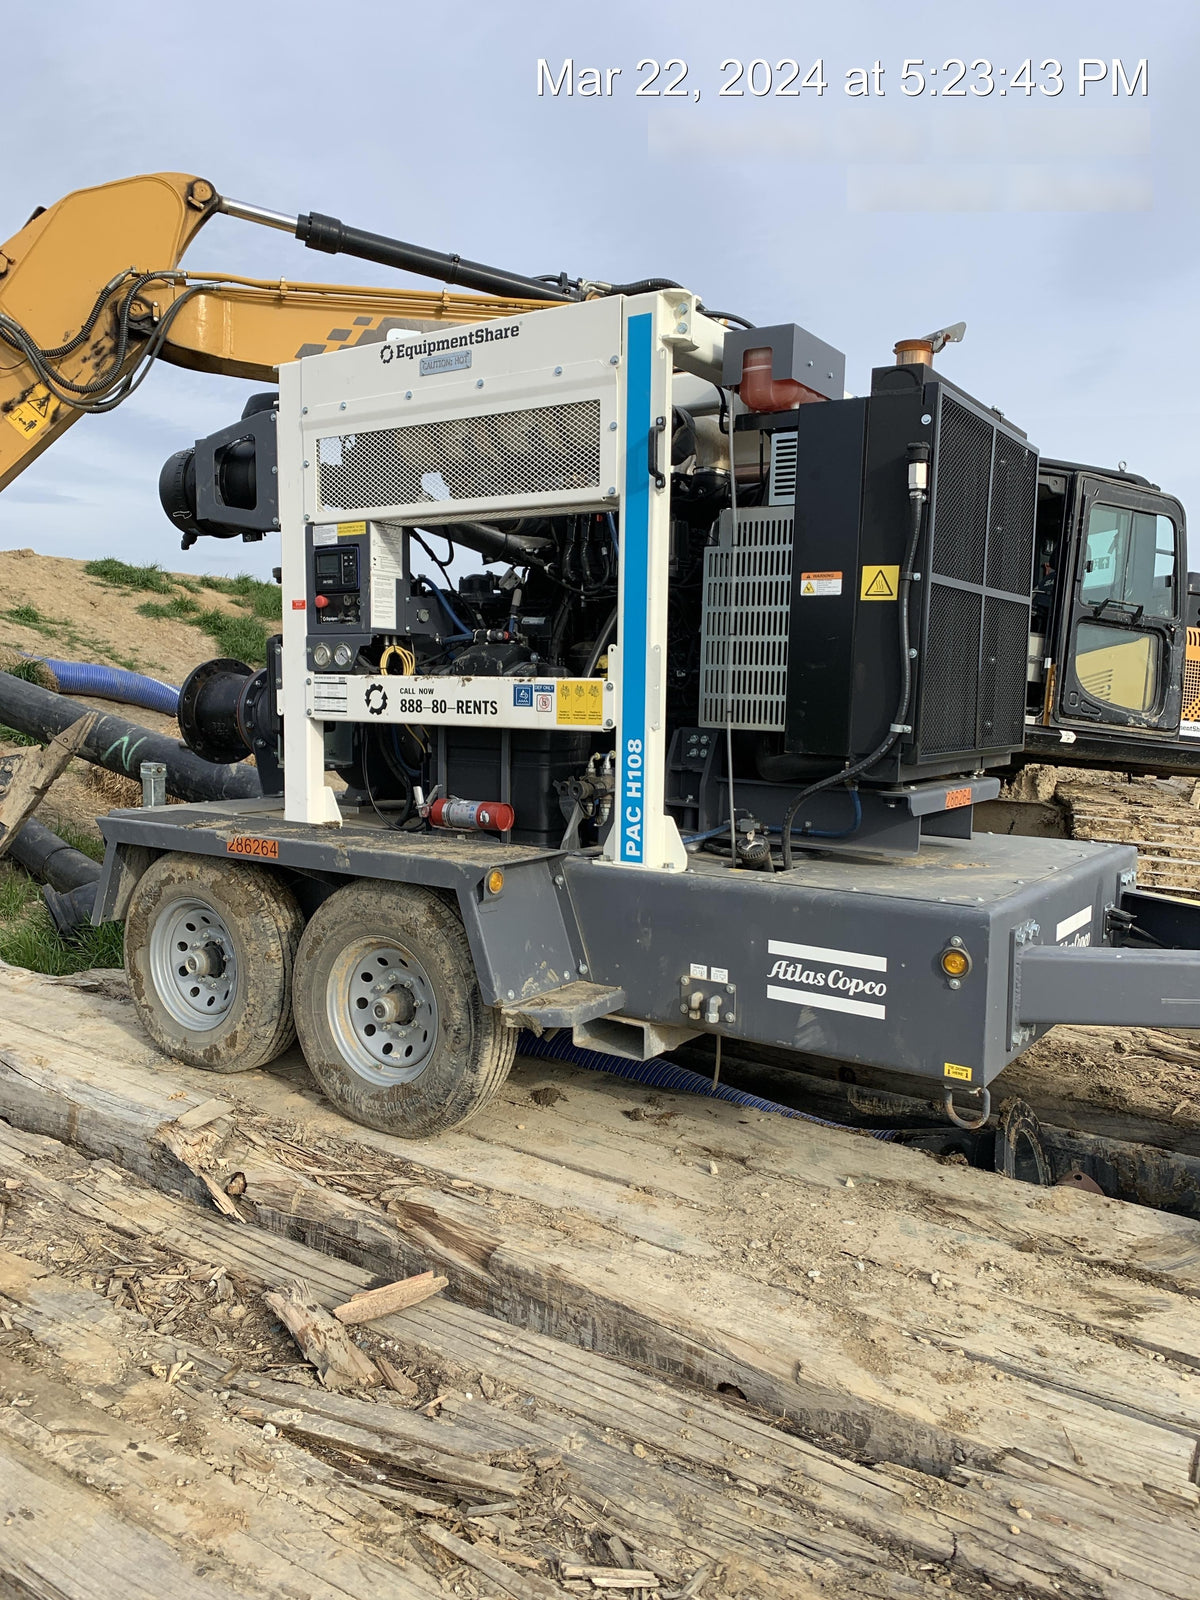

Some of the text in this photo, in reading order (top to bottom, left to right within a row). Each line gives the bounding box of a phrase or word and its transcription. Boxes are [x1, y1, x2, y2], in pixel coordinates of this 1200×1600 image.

[396, 325, 520, 360] EquipmentShare
[454, 355, 469, 367] HOT
[625, 738, 643, 857] PAC H108
[228, 837, 278, 857] 286264
[766, 960, 887, 997] Atlas Copco
